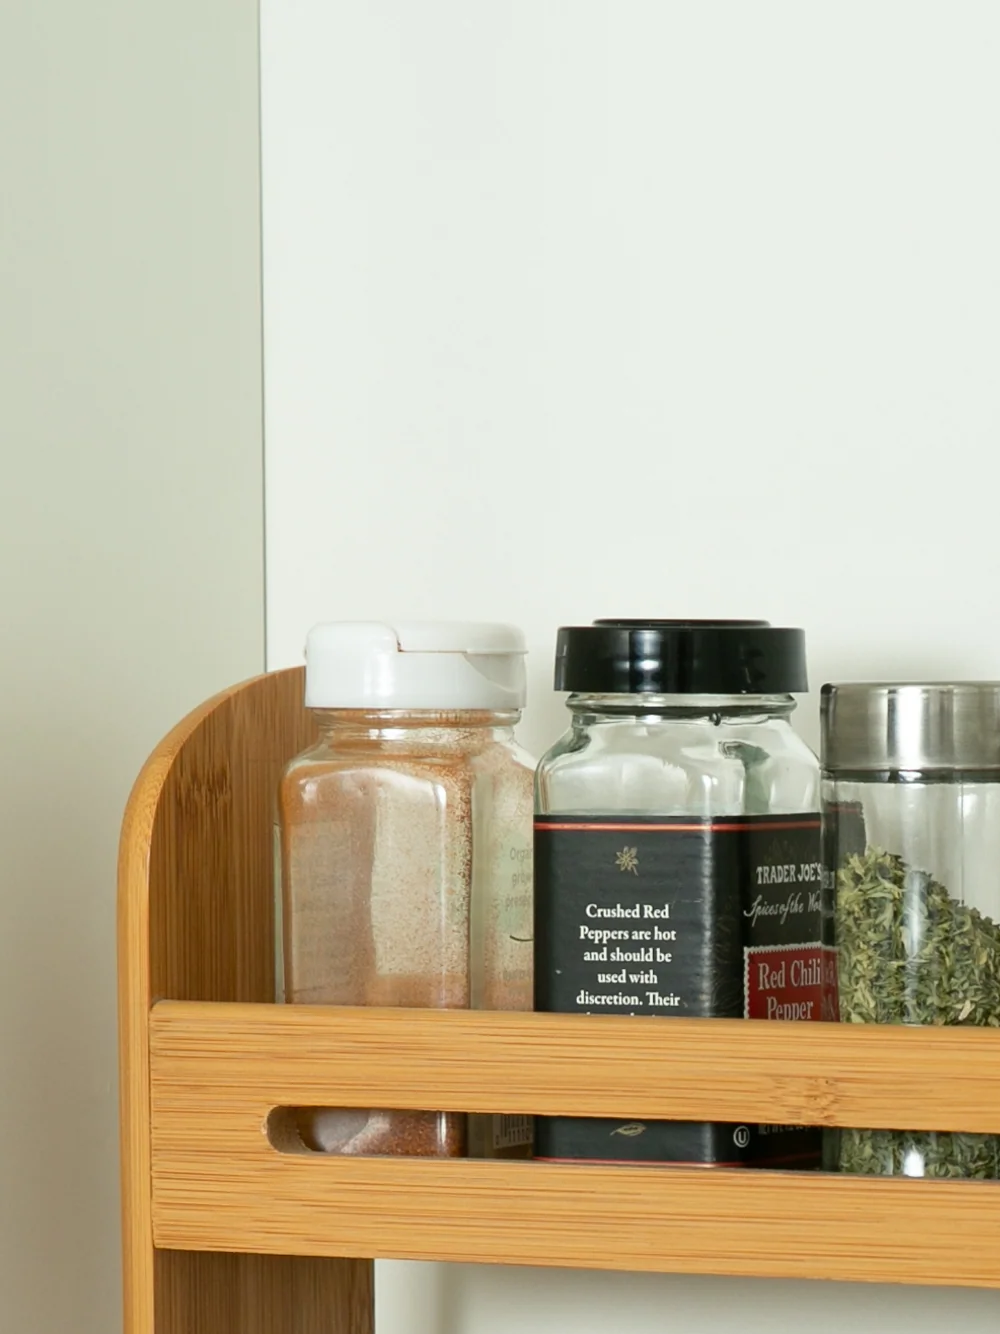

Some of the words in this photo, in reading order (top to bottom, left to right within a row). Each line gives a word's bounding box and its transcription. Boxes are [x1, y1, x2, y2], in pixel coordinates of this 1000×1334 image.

[756, 864, 796, 884] TRADER
[797, 862, 821, 882] JOE'S
[585, 903, 640, 918] Crushed
[643, 904, 670, 919] Red
[743, 894, 779, 927] Spices
[790, 892, 804, 914] the
[579, 925, 629, 944] Peppers
[631, 930, 651, 940] are
[654, 926, 676, 941] hot
[583, 947, 608, 961] and
[610, 947, 654, 962] should
[656, 948, 672, 962] be
[597, 969, 627, 983] used
[629, 969, 658, 984] with
[758, 961, 786, 990] Red
[790, 958, 821, 987] Chili
[576, 990, 643, 1005] discretion.
[645, 992, 681, 1006] Their
[766, 997, 814, 1020] Pepper
